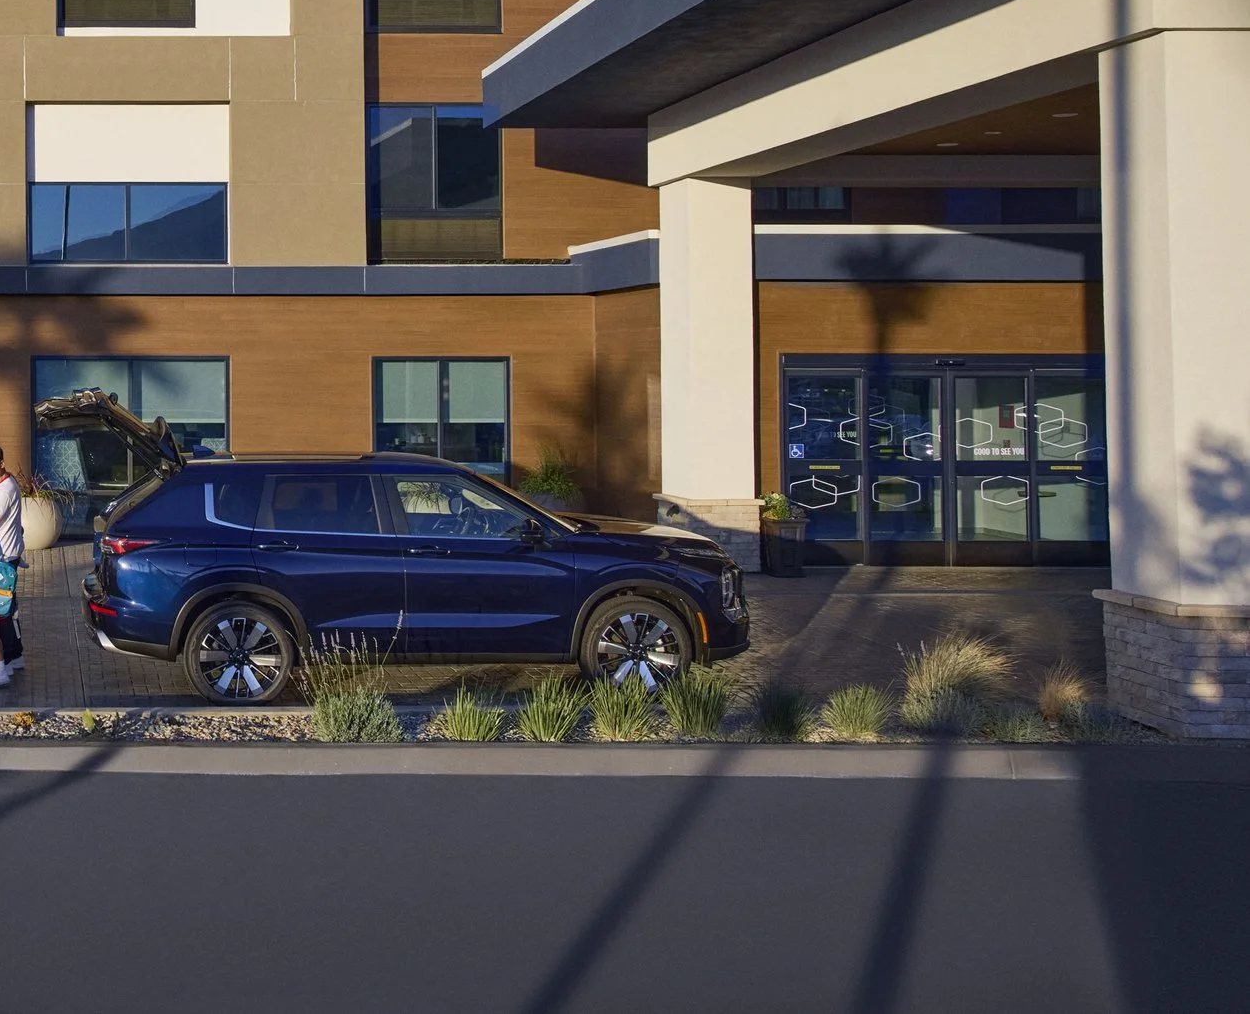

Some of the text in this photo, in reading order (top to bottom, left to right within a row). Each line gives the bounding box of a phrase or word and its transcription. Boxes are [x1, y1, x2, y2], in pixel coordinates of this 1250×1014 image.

[991, 447, 1000, 456] TO
[1000, 447, 1011, 456] SEE
[1011, 447, 1025, 456] YOU
